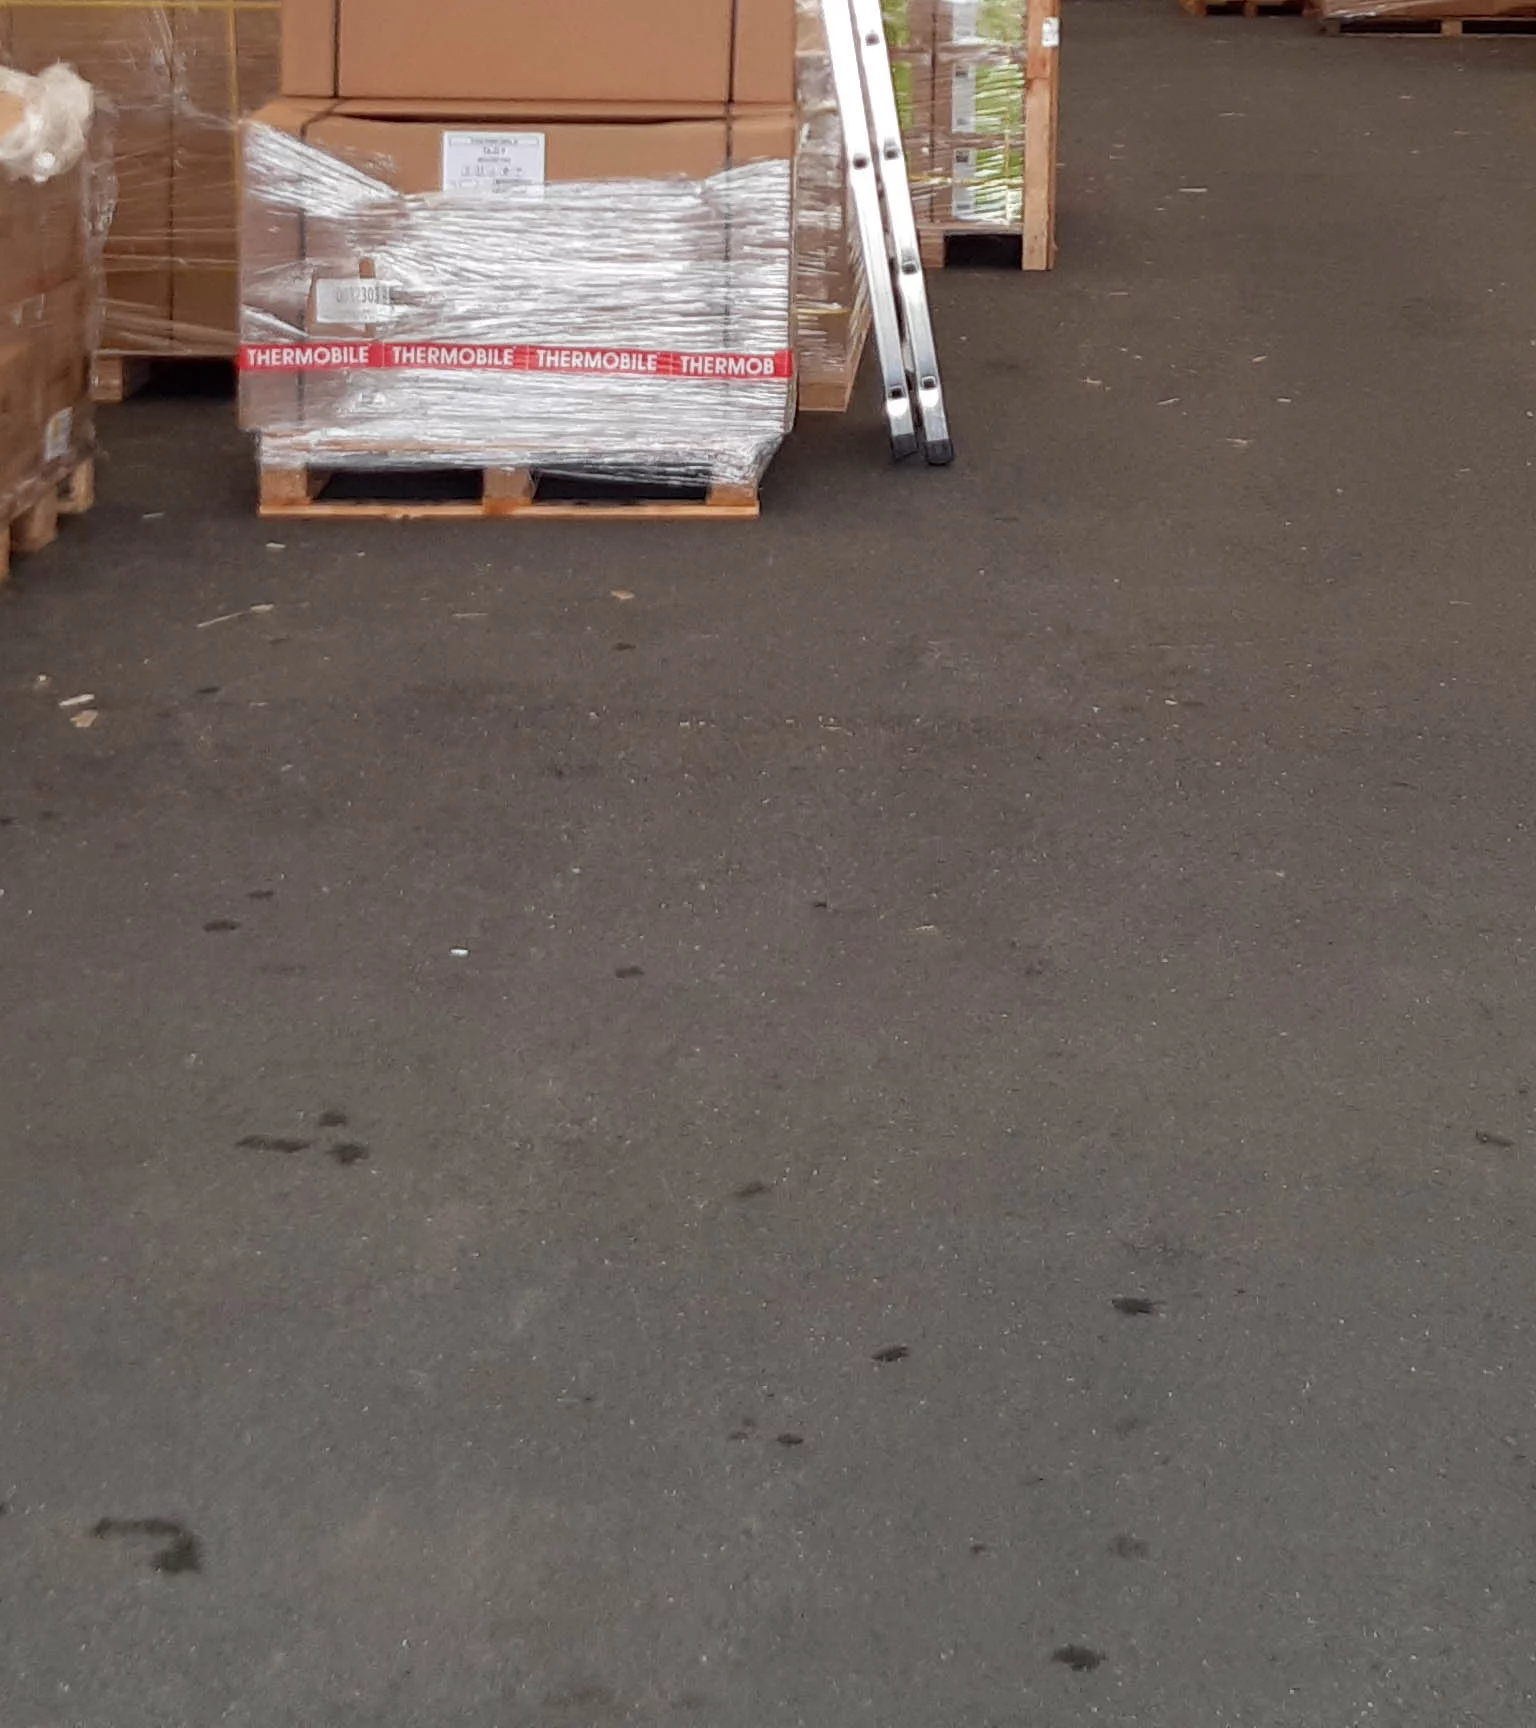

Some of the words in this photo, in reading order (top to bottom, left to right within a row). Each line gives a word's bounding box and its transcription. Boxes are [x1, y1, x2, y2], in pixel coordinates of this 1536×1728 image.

[248, 346, 369, 366] THERMOBILE
[392, 347, 514, 366] THERMOBILE
[536, 349, 658, 371] THERMOBILE
